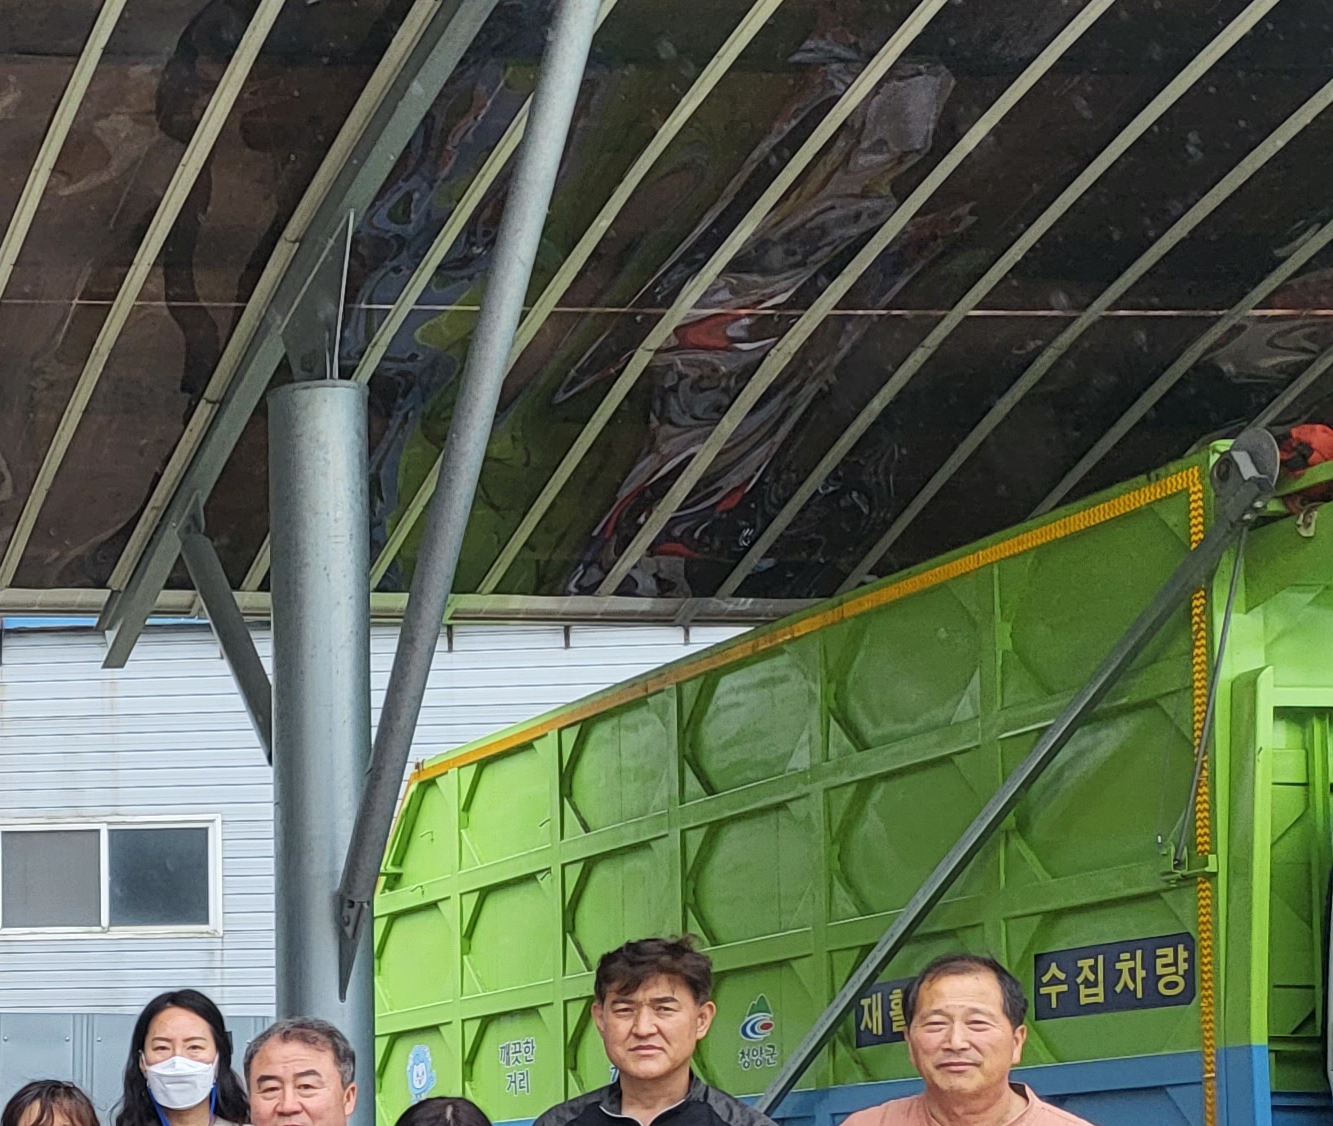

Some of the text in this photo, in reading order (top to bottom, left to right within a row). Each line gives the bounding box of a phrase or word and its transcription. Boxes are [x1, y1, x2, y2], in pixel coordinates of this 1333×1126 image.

[1039, 943, 1189, 1009] 수집차량
[499, 1037, 536, 1067] 깨끗한
[739, 1043, 778, 1071] 청양군
[506, 1069, 531, 1096] 거리
